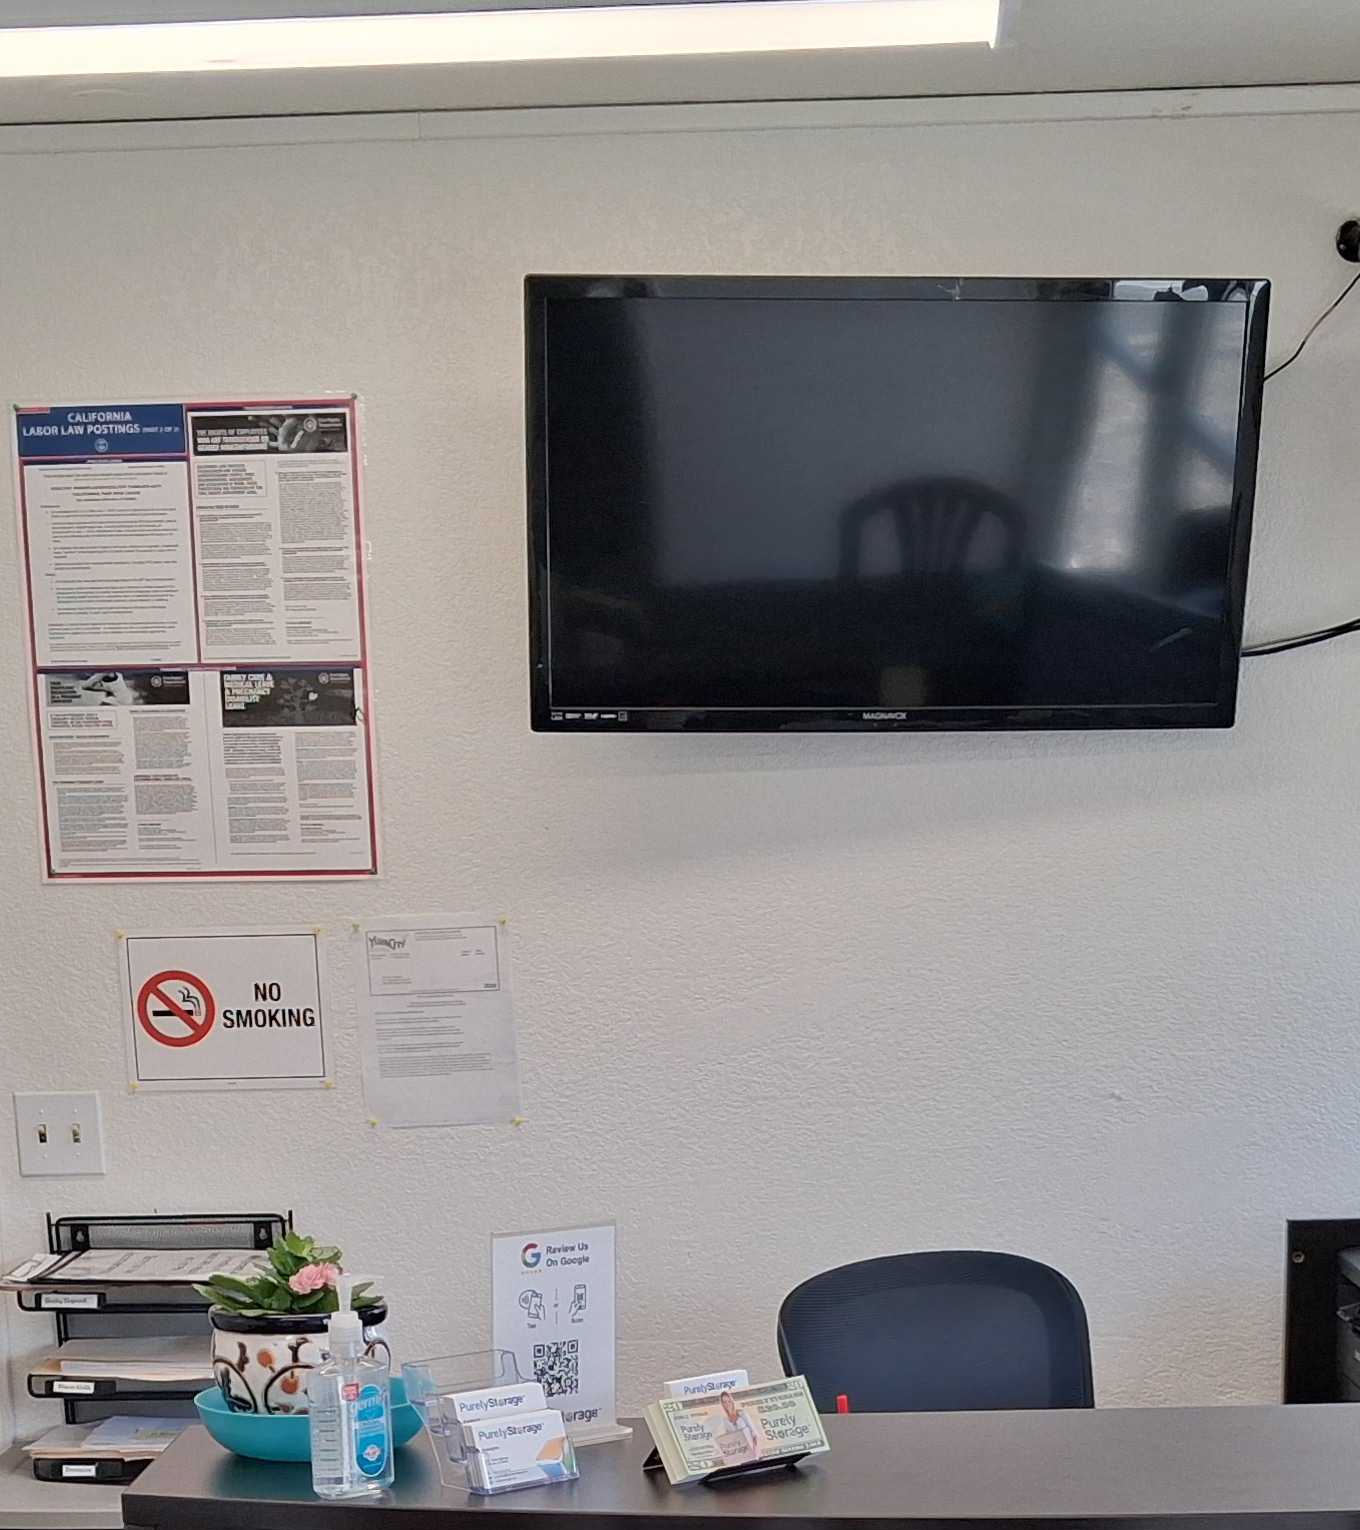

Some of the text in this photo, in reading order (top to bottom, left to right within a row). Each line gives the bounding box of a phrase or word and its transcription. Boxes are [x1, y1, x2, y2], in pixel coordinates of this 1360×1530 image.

[67, 411, 133, 423] CALIFORNIA
[22, 425, 58, 436] LABOR
[61, 425, 84, 435] LAW
[87, 424, 141, 434] POSTINGS
[253, 982, 282, 1002] NO
[222, 1007, 316, 1029] SMOKING
[546, 1242, 589, 1255] Review Us
[546, 1255, 590, 1267] On Google
[683, 1379, 736, 1395] PurelyStorage
[459, 1395, 524, 1412] PurelyStorage
[760, 1413, 797, 1430] Purely
[478, 1424, 542, 1440] PurelyStorage
[764, 1423, 810, 1441] Storage
